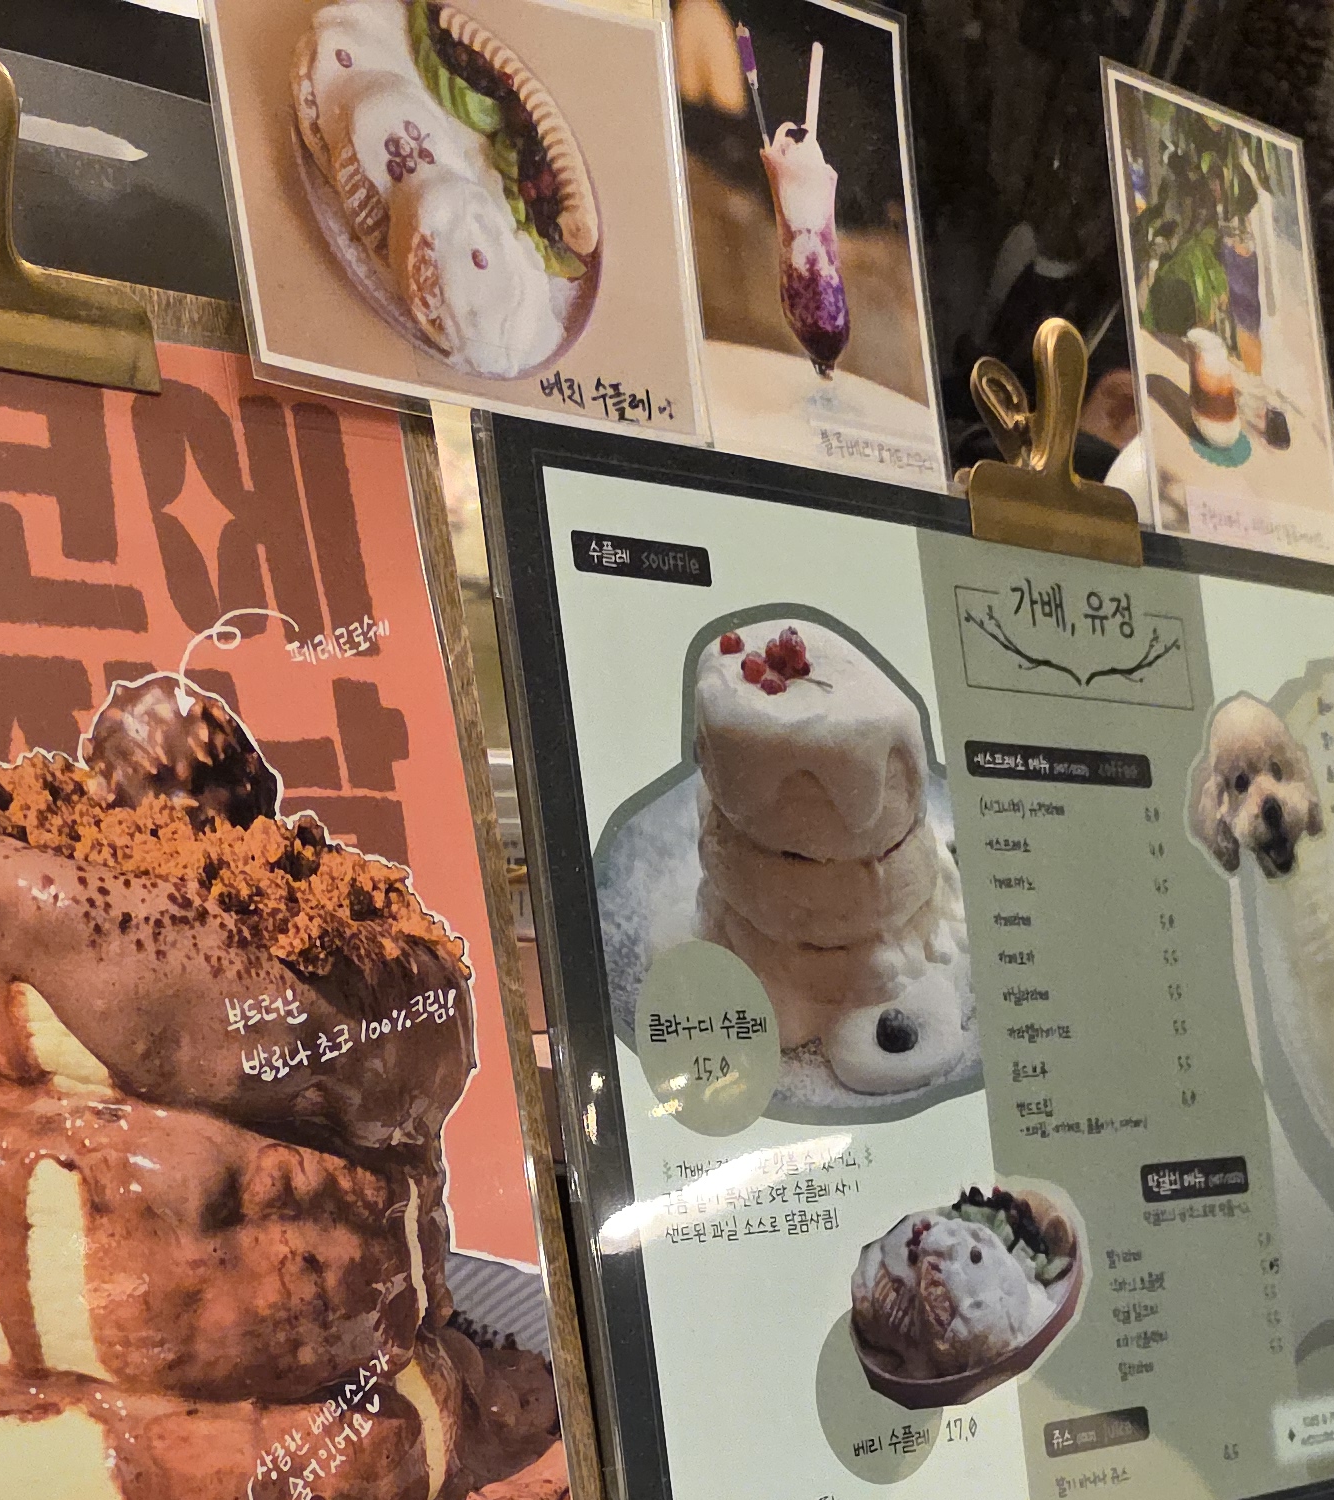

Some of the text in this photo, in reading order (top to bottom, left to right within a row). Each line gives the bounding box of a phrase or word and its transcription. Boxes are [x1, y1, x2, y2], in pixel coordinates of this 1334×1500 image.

[540, 371, 653, 422] 베리 수플레
[589, 540, 630, 568] 수플레
[1010, 578, 1134, 638] 가배, 유정
[285, 614, 390, 665] 페레로로쉐
[973, 753, 1025, 771] 에스프레소
[225, 989, 307, 1035] 부드러운
[649, 1010, 767, 1042] 클라우디 수플레
[241, 989, 457, 1082] 발로나 초코 100% 크림!
[792, 1179, 831, 1205] 수플레
[711, 1217, 739, 1241] 과일
[744, 1215, 781, 1235] 소스로
[257, 1428, 310, 1480] 상큼한
[853, 1439, 882, 1457] 베리
[888, 1424, 930, 1455] 수플레
[1052, 1429, 1073, 1447] 쥬스
